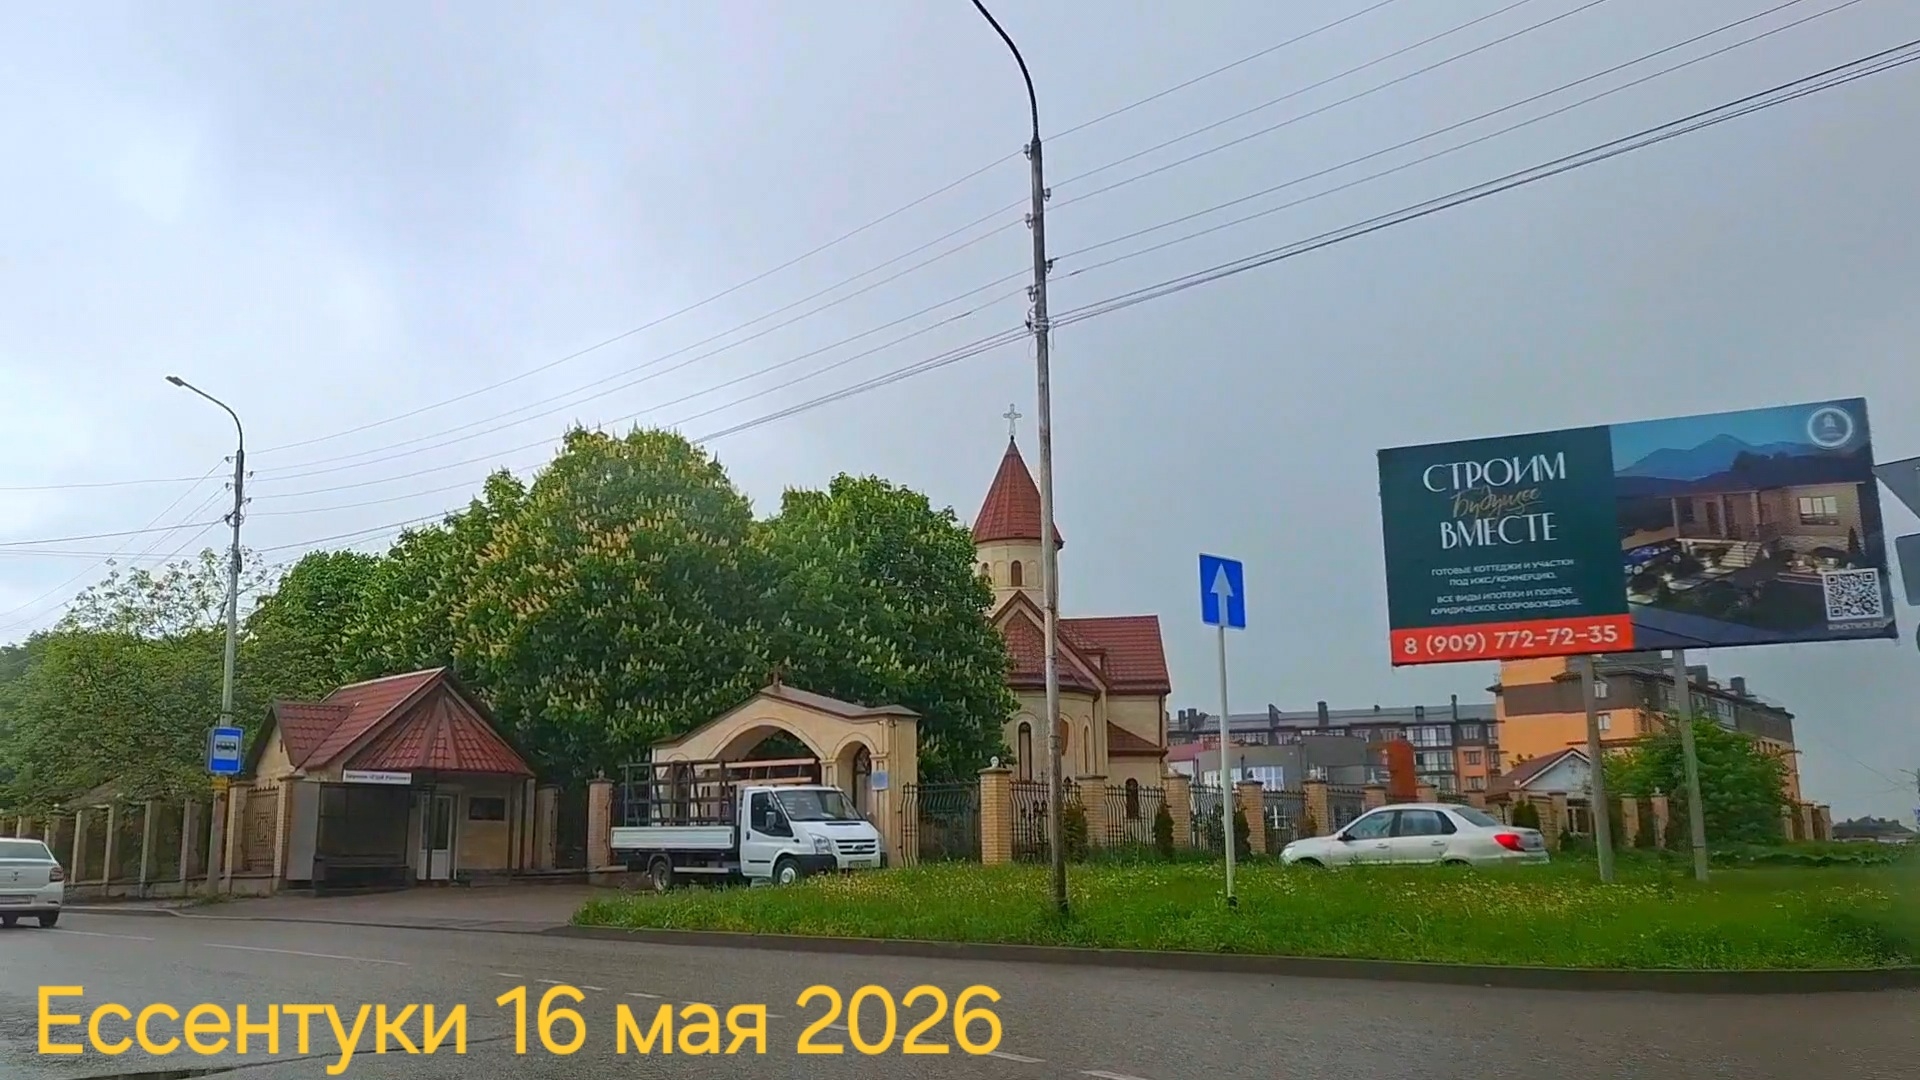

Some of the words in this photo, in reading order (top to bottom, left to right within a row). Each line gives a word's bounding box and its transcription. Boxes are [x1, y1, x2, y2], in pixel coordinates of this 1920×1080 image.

[1423, 452, 1566, 492] СТРОИМ
[1440, 512, 1558, 549] ВМЕСТЕ
[1431, 566, 1472, 576] ГОТОВЫЕ
[1473, 563, 1522, 573] КОТТЕДЖИ
[1532, 559, 1574, 569] УЧАСТКИ
[1449, 578, 1469, 586] ПОД
[1437, 595, 1454, 604] ВСЕ
[1455, 594, 1482, 602] ВИДЫ
[1483, 591, 1525, 600] ИПОТЕКИ
[1535, 587, 1573, 596] ПОЛНОЕ
[1431, 604, 1497, 615] ЮРИДИЧЕСКОЕ
[1404, 637, 1417, 654] 8
[1426, 631, 1486, 655] (909)
[1494, 625, 1618, 649] 772-72-35
